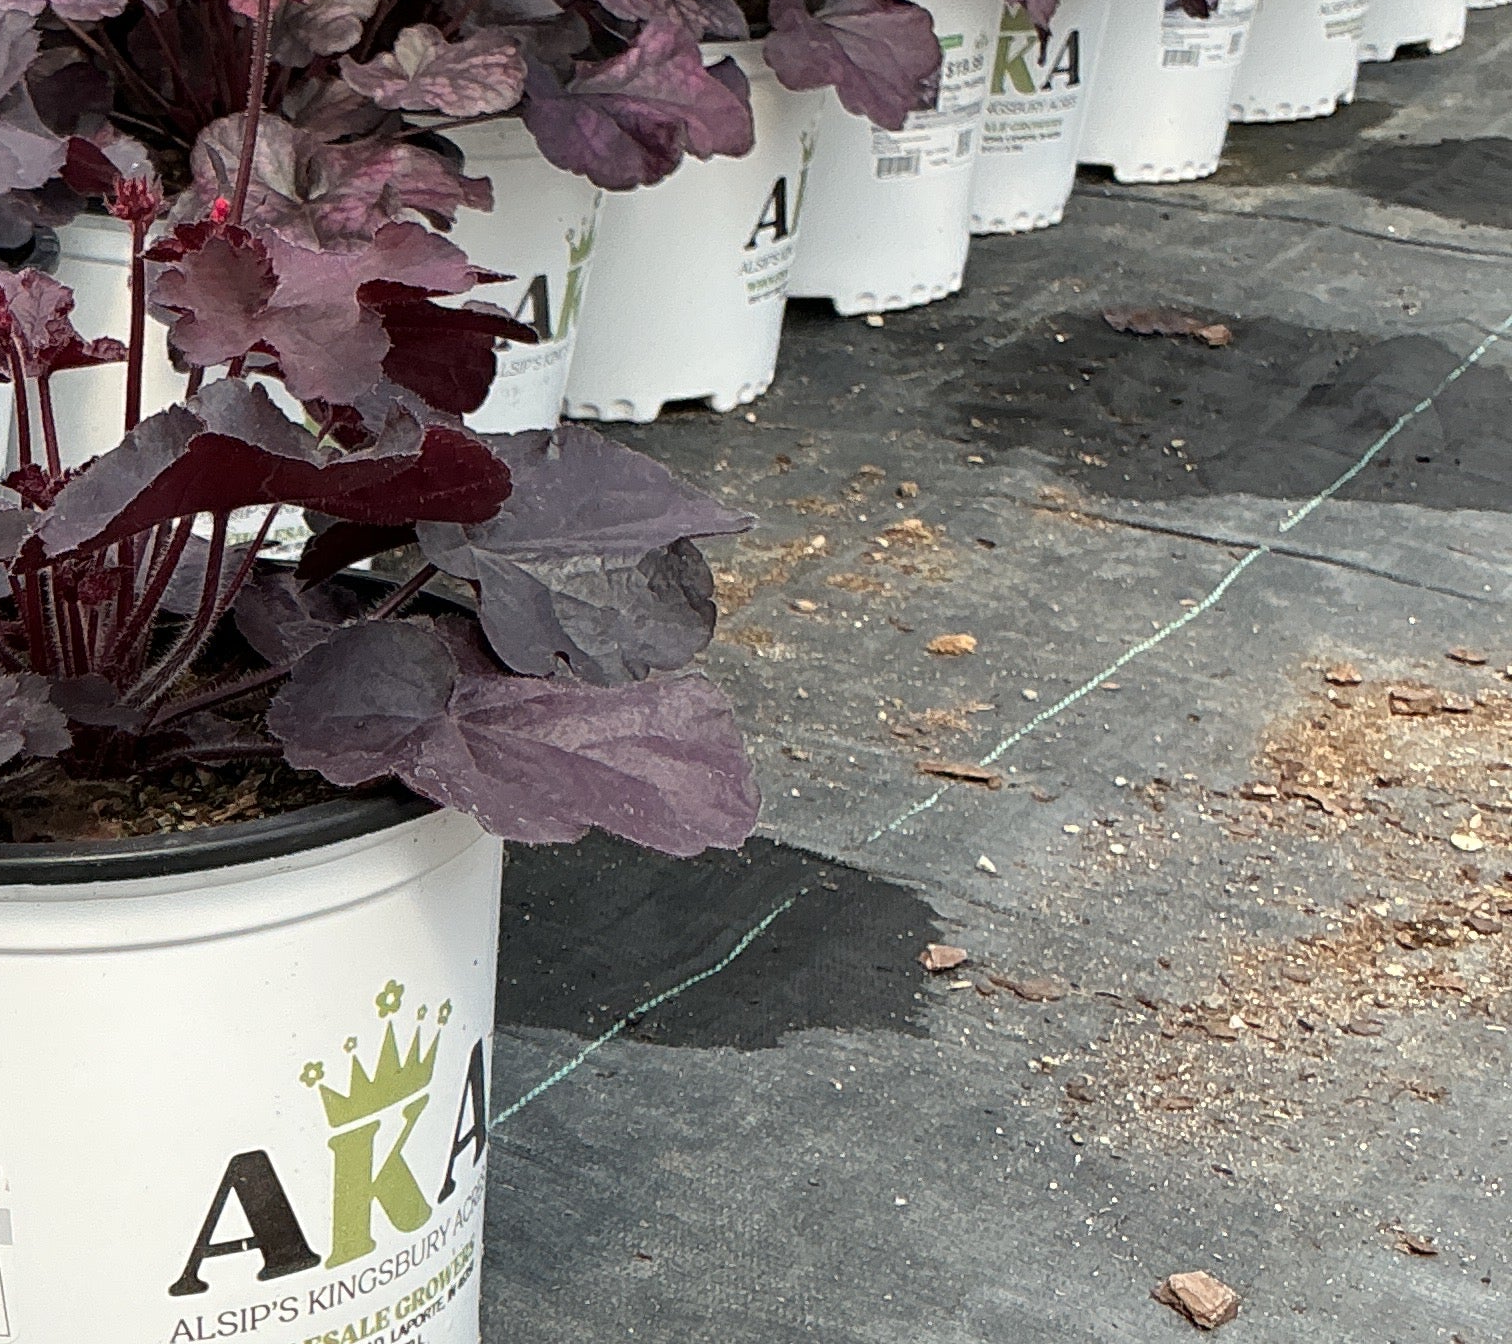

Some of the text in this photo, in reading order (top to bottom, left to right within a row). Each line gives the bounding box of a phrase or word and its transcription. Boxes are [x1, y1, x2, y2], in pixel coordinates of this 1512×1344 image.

[990, 30, 1079, 93] KA
[168, 1038, 487, 1297] AKA
[170, 1296, 299, 1344] ALSIP'S
[308, 1218, 450, 1315] KINGSBURY
